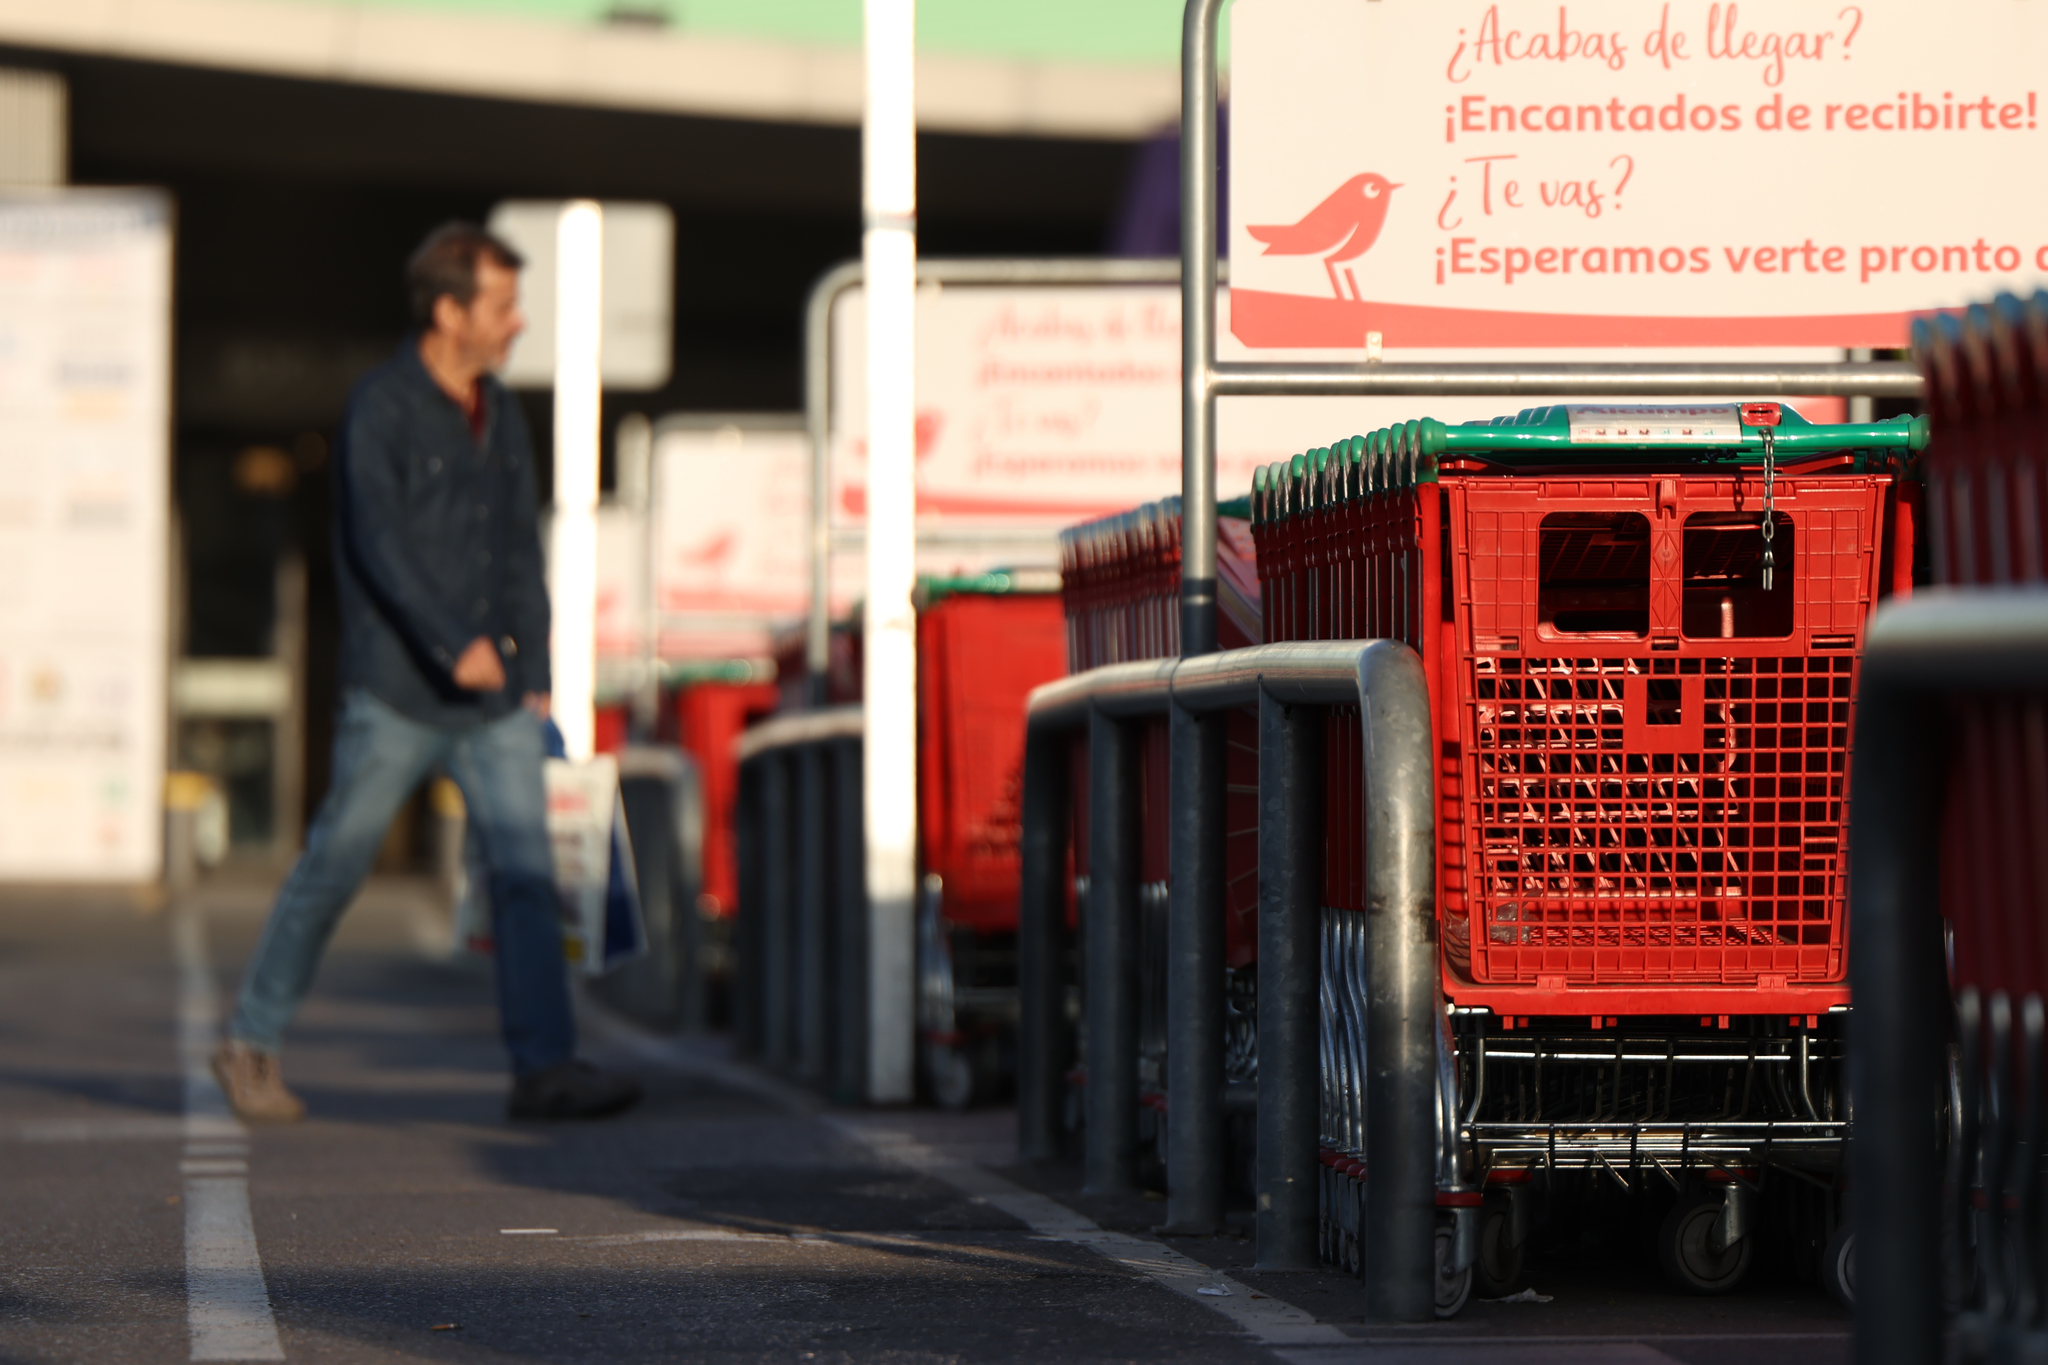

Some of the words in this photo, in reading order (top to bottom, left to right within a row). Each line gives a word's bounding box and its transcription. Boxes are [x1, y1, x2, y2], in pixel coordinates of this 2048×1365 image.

[1446, 4, 1628, 83] ¿Acabas
[1643, 2, 1691, 69] de
[1707, 2, 1863, 86] llegar?
[1446, 93, 1741, 143] ¡Encantados
[1755, 93, 1811, 131] de
[1825, 91, 2038, 131] recibirte!
[1437, 154, 1523, 230] ¿Te
[1540, 154, 1634, 218] vas?
[1436, 237, 1710, 285] ¡Esperamos
[1724, 239, 1846, 273] verte
[1860, 238, 2021, 284] pronto
